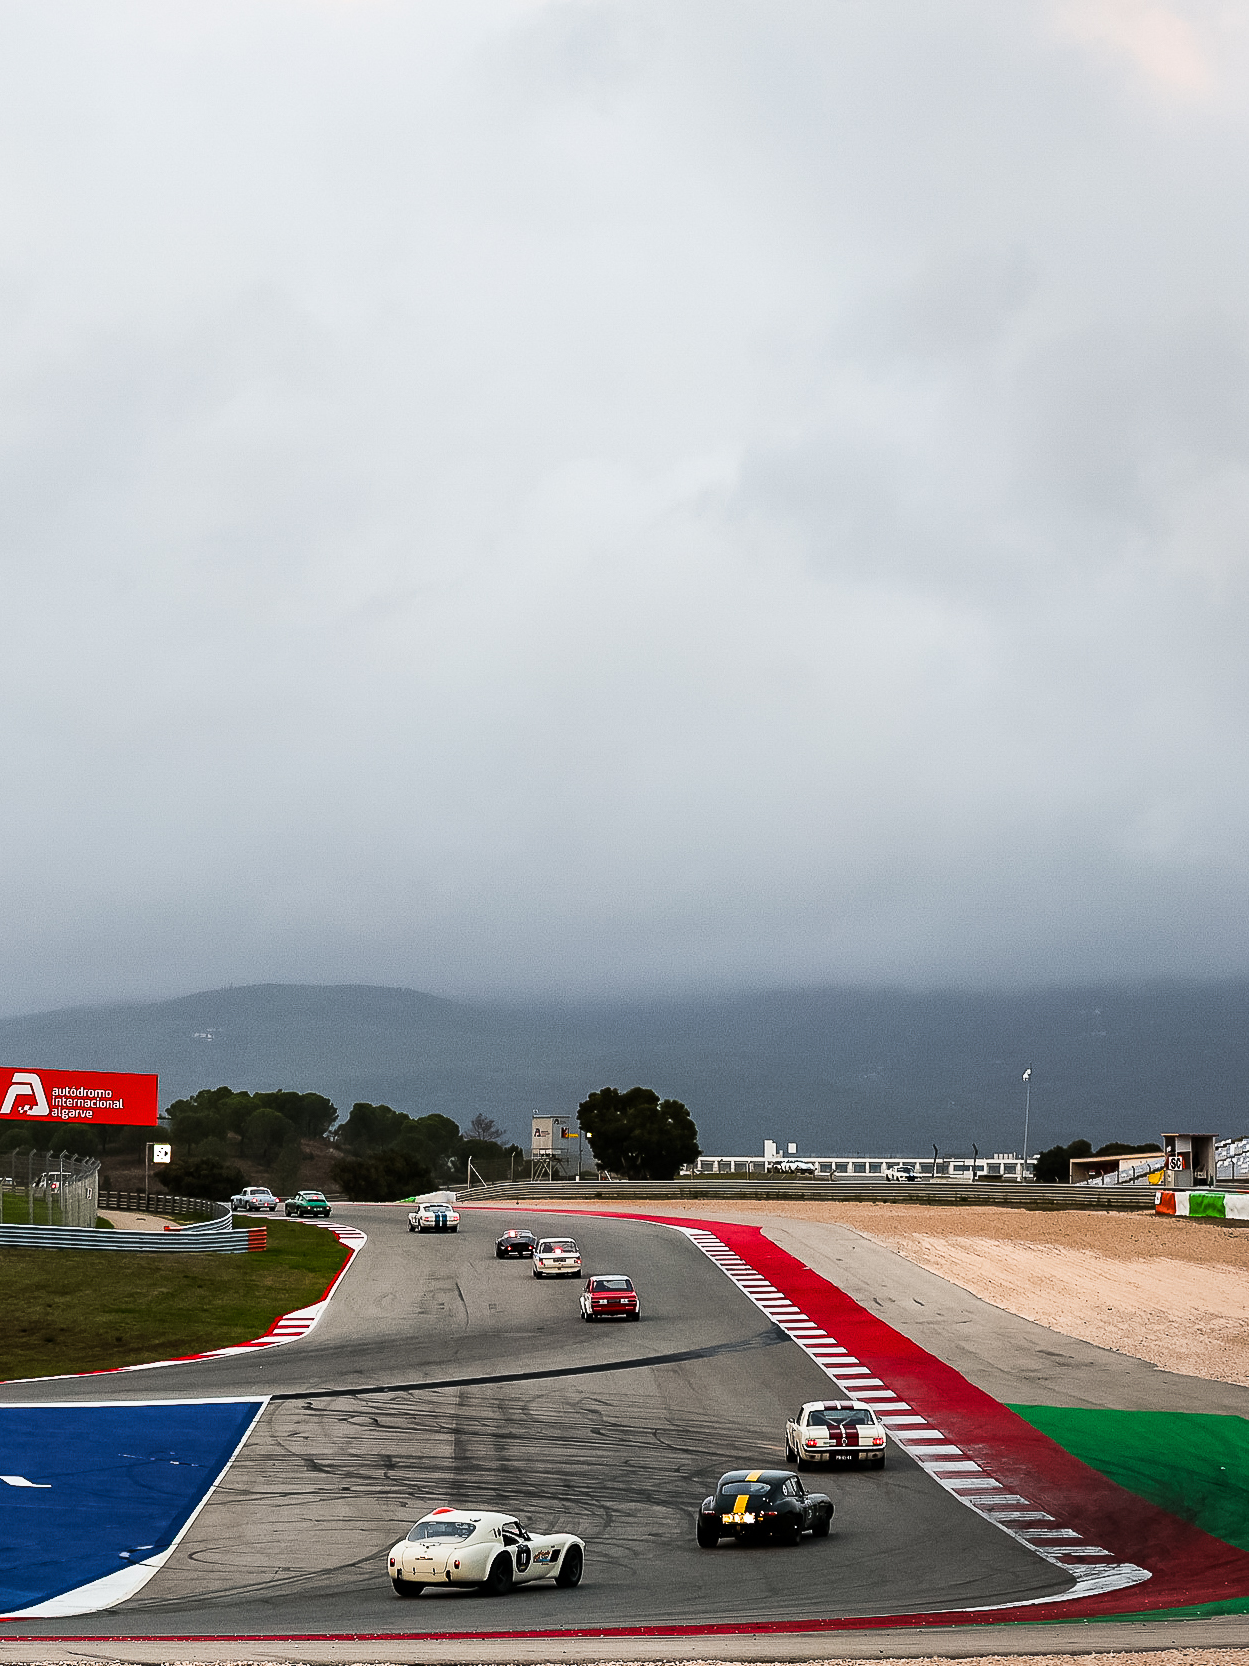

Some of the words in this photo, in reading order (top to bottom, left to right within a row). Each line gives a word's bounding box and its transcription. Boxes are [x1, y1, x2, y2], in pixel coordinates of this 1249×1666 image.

[51, 1086, 112, 1098] autódromo
[51, 1096, 124, 1109] internacional
[51, 1107, 93, 1120] algarve
[1170, 1158, 1181, 1169] SC
